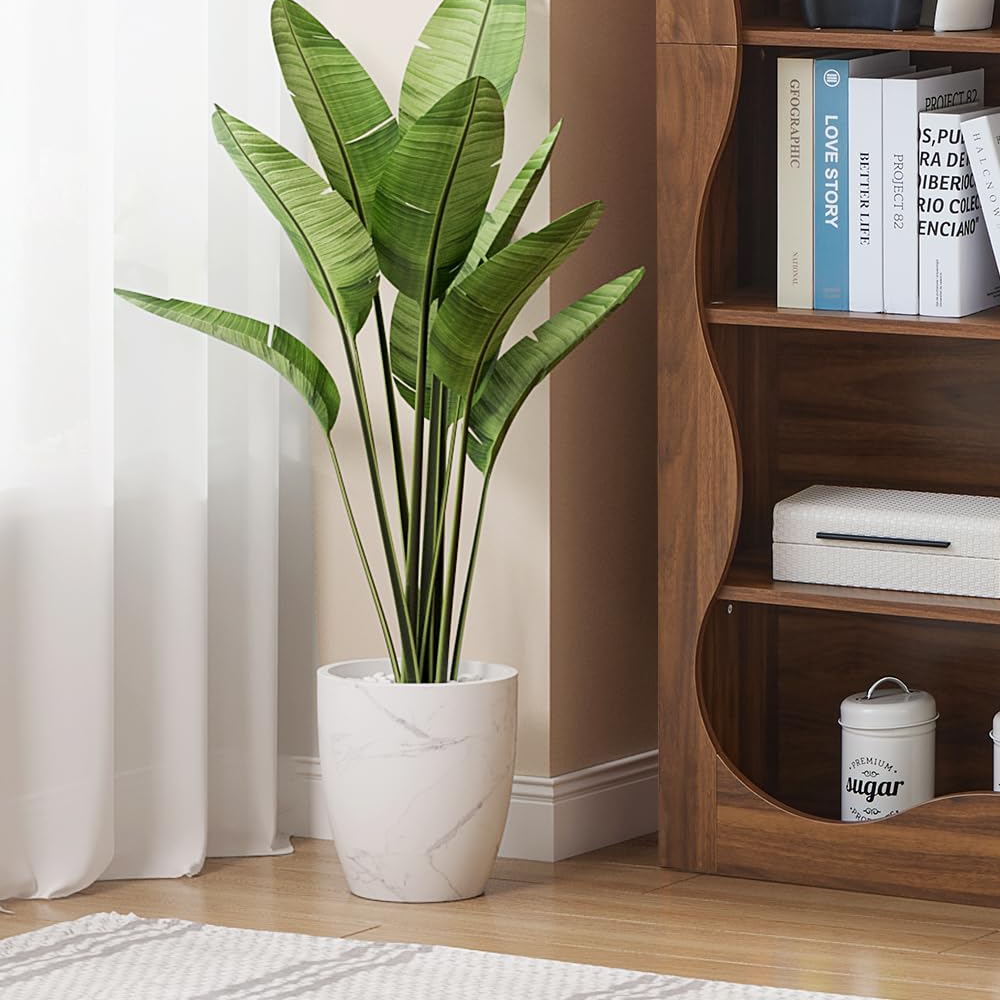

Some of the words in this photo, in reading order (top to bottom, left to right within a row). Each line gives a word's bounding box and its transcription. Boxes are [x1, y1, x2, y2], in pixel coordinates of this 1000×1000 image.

[825, 115, 838, 162] LOVE
[860, 153, 869, 208] BETTER
[892, 154, 904, 210] PROJECT
[825, 168, 838, 228] STORY
[949, 195, 982, 214] COLEC
[860, 214, 870, 245] LIFE
[894, 213, 904, 229] 82
[851, 757, 893, 772] PREMIUM
[846, 777, 904, 802] sugar
